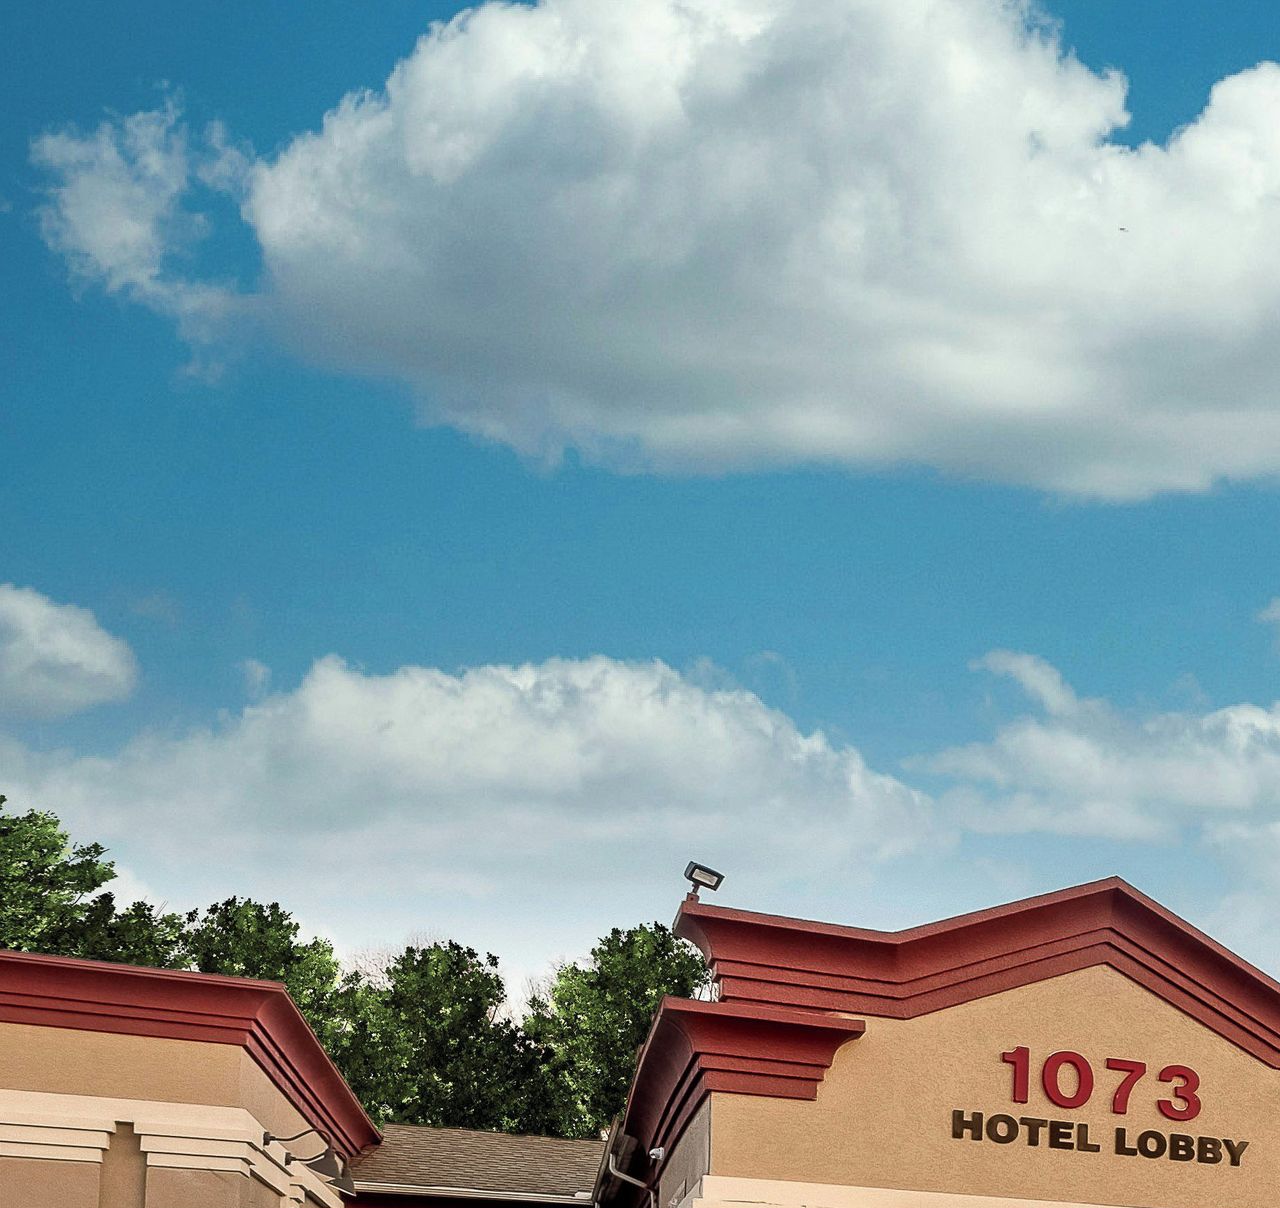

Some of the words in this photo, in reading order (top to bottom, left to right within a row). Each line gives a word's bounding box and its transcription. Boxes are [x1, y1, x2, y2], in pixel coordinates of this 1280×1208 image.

[1001, 1046, 1202, 1121] 1073
[952, 1109, 1100, 1152] HOTEL
[1115, 1127, 1249, 1166] LOBBY
